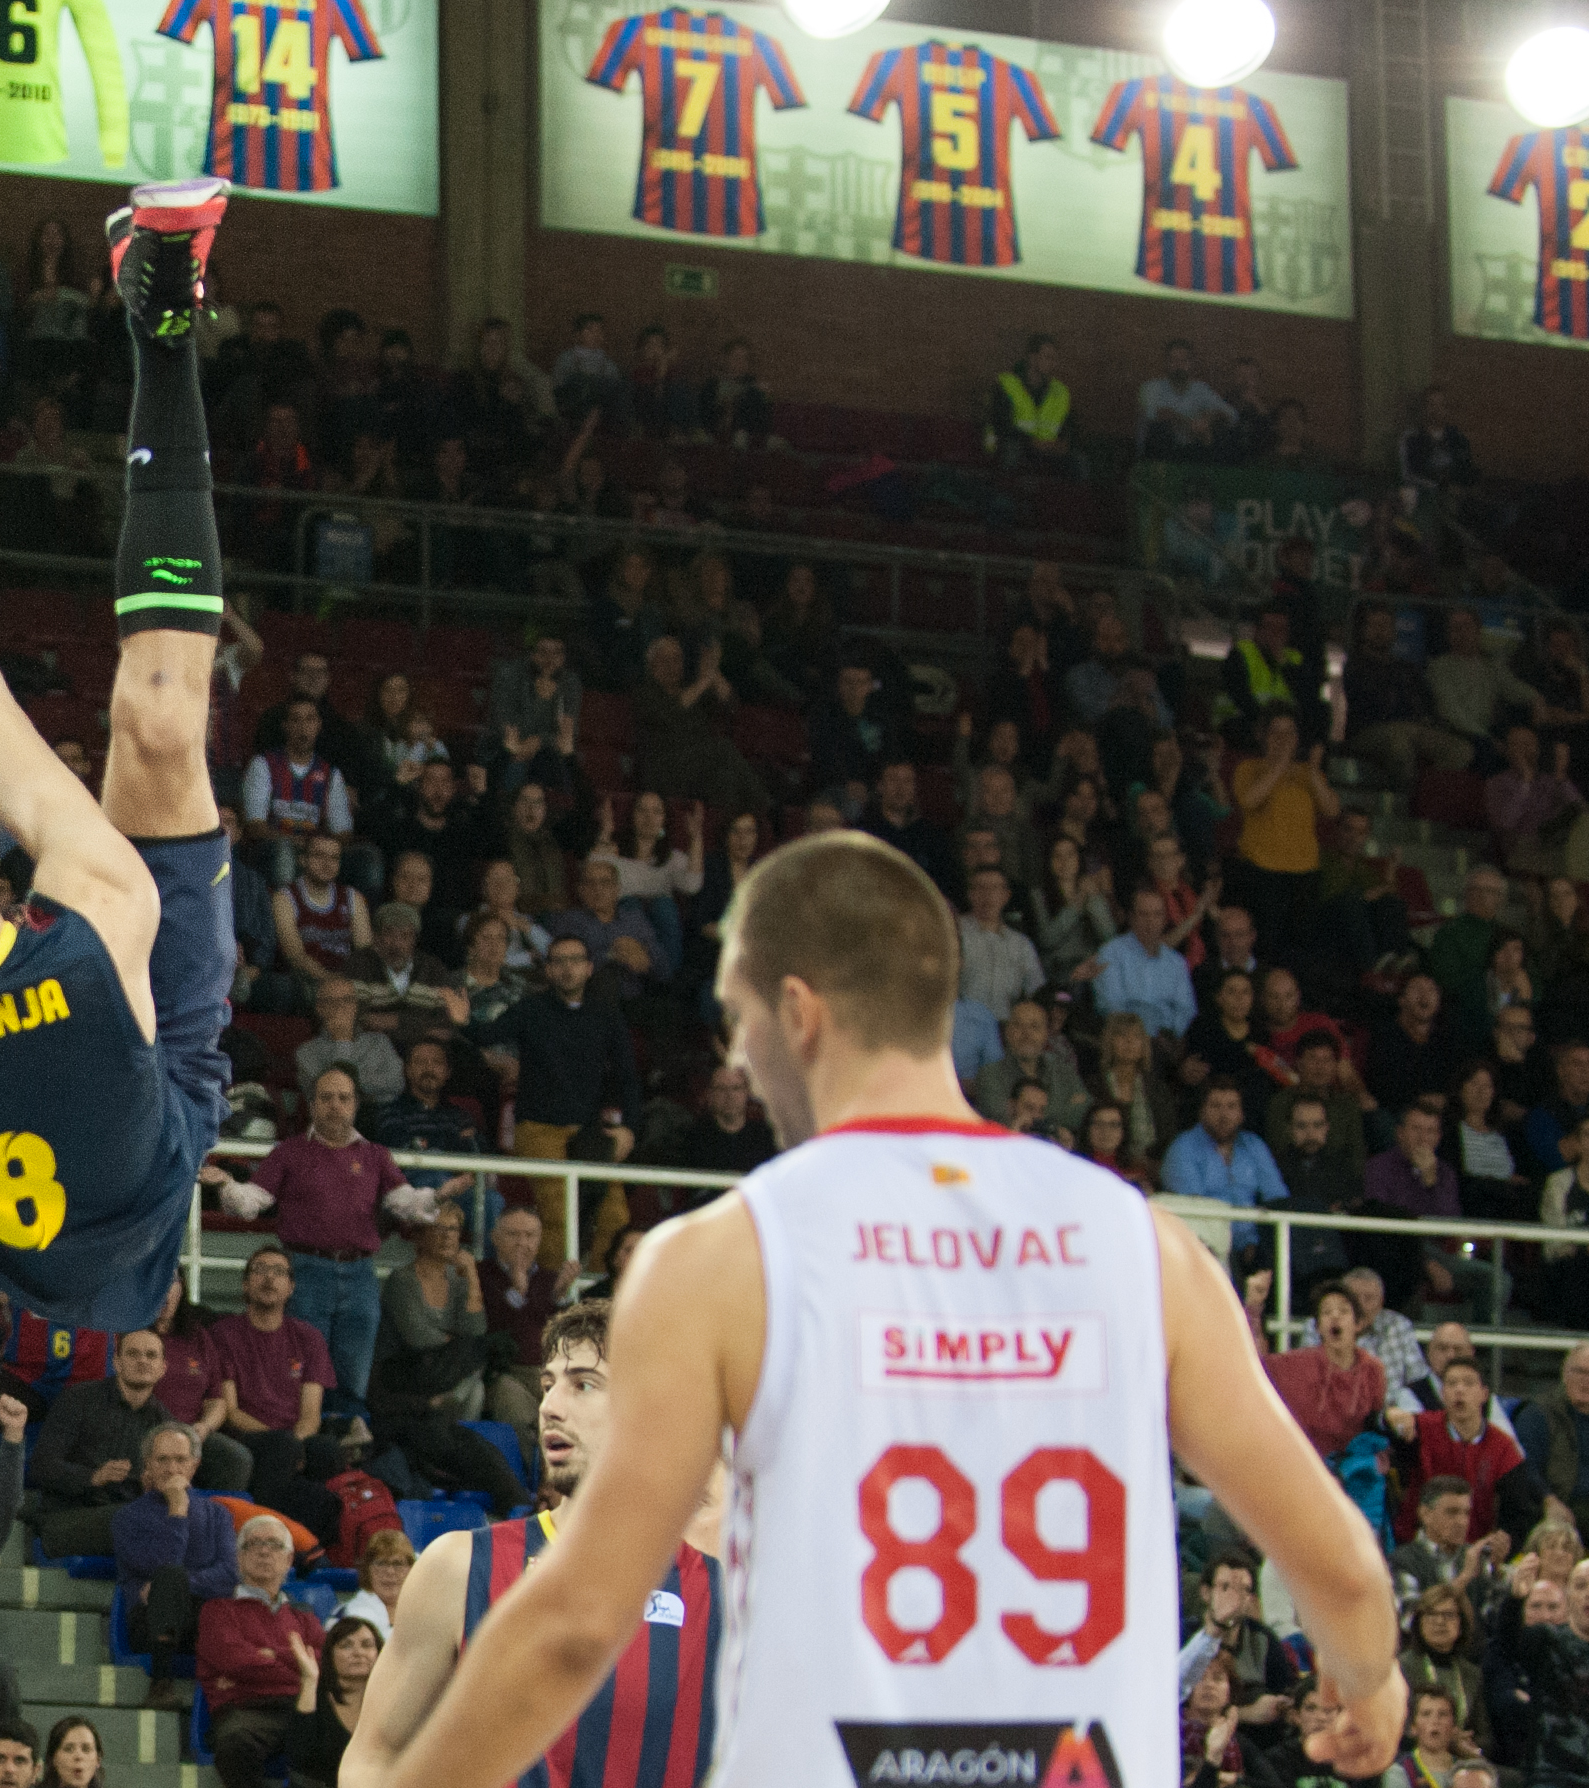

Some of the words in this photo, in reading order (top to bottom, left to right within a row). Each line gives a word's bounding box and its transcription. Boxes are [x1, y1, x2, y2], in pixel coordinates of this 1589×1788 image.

[231, 13, 319, 99] 14
[675, 58, 721, 139] 7
[931, 91, 980, 171] 5
[1170, 125, 1223, 202] 4
[852, 1222, 1088, 1270] JELOVAC
[52, 1329, 72, 1360] 6
[858, 1443, 1126, 1666] 89
[868, 1741, 1037, 1785] ARAGÓN
